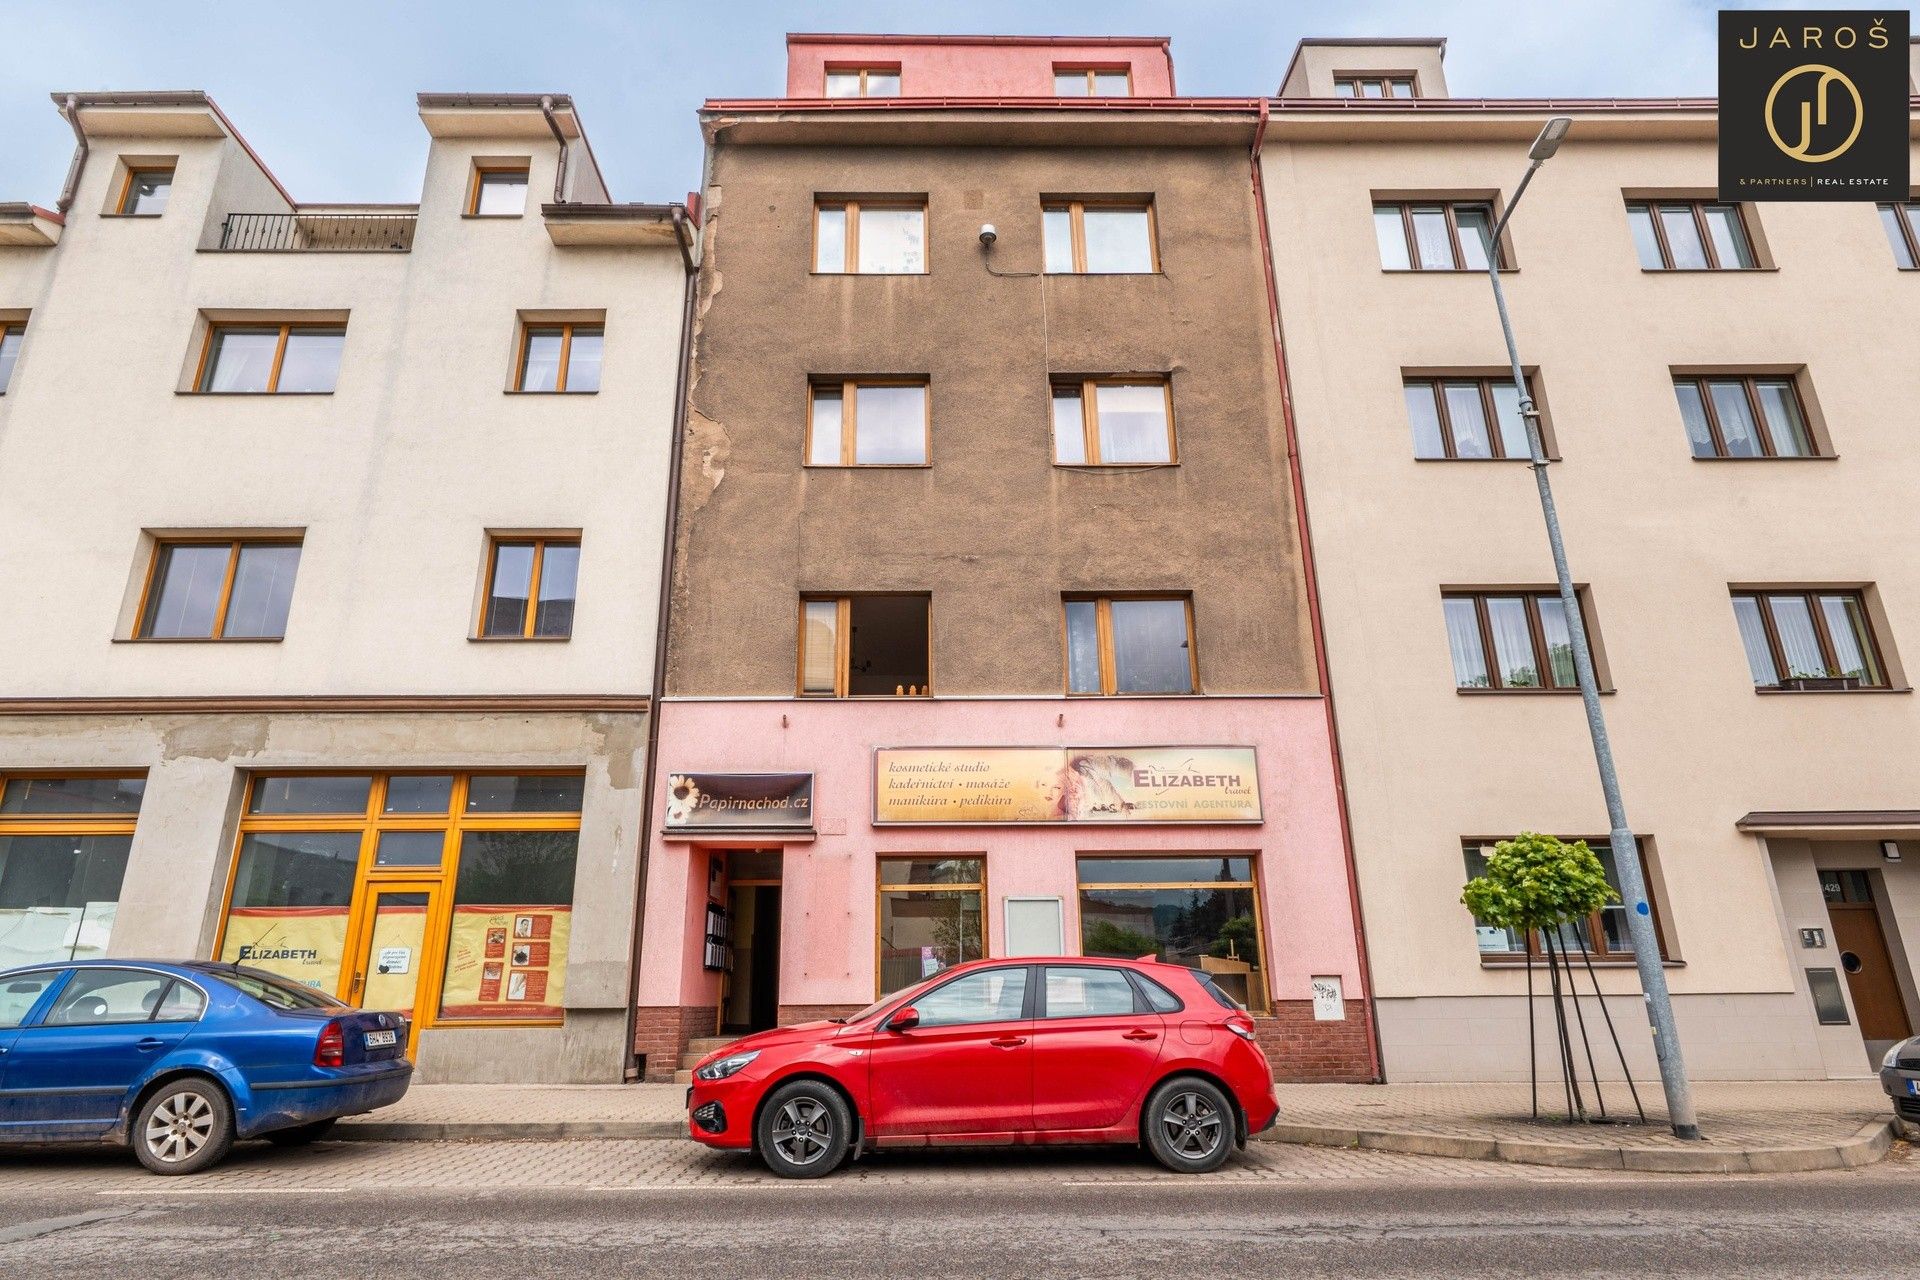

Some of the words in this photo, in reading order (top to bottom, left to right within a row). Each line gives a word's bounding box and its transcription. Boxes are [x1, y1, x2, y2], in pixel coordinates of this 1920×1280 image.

[888, 761, 951, 772] kosmetické
[954, 761, 990, 772] studio
[966, 778, 1011, 789] masáže
[1133, 770, 1241, 787] ELIZABETH
[1225, 786, 1251, 795] travel
[699, 794, 808, 811] Papirnachod.cz
[888, 794, 947, 806] manikúra
[959, 794, 1012, 808] pedikúra
[1194, 800, 1252, 809] AGENTURA
[239, 945, 317, 960] ELIZABETH
